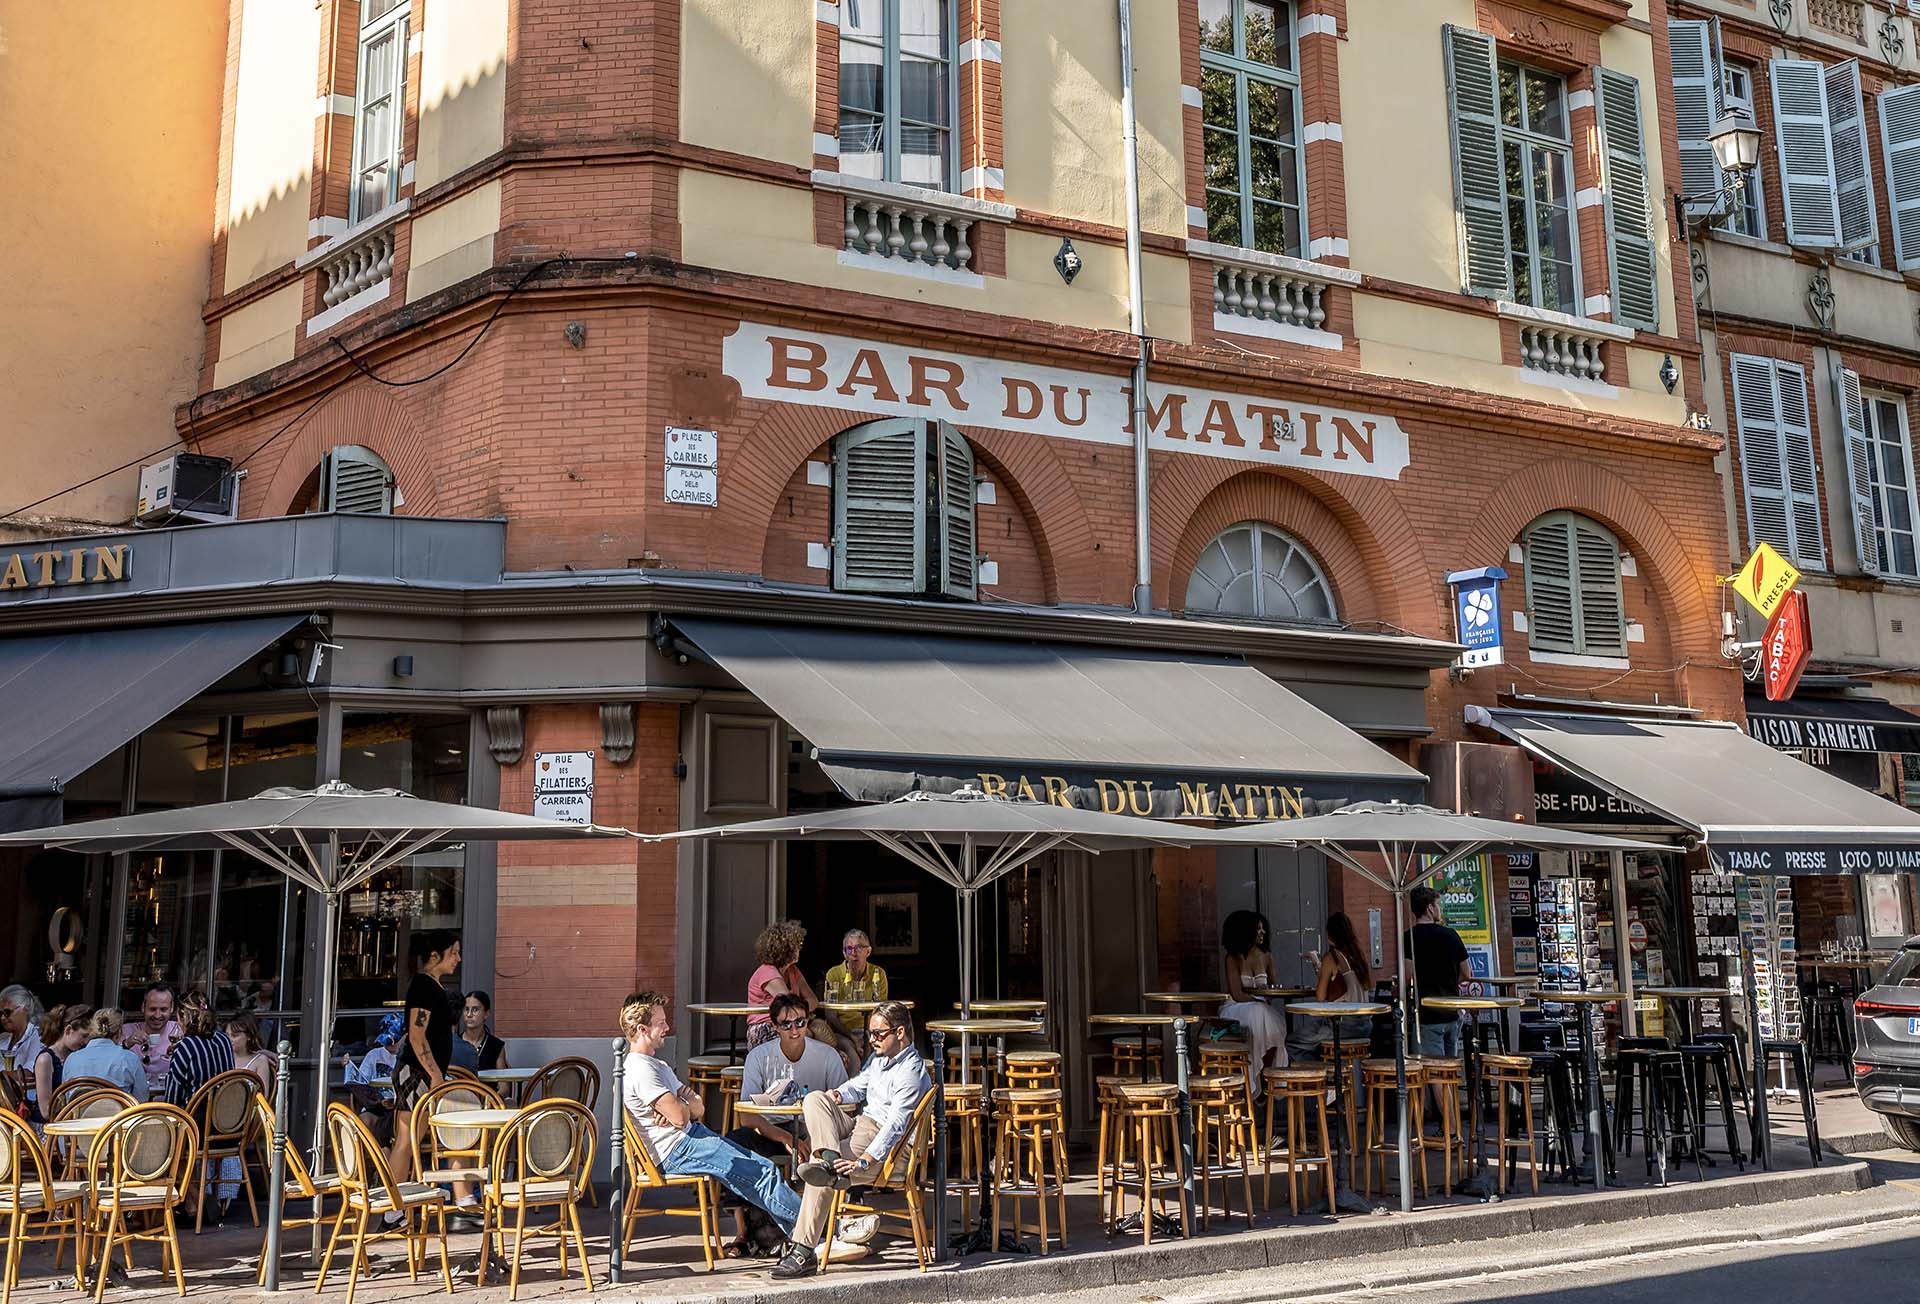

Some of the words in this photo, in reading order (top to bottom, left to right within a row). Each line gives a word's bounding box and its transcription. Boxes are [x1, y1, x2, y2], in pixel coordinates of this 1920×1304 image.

[765, 336, 969, 411] BAR
[1001, 376, 1091, 426] DU
[1120, 386, 1376, 463] MATIN
[681, 432, 703, 442] PLACE
[673, 451, 708, 464] CARMES
[671, 489, 712, 503] CARMES
[0, 544, 128, 589] ATIN
[1761, 569, 1793, 611] PRESSE
[1769, 617, 1787, 682] TABAC
[1746, 718, 1803, 746] AISON
[1806, 721, 1877, 750] SARMENT
[555, 755, 573, 764] RUE
[559, 767, 569, 775] DES
[540, 777, 587, 789] FILATIERS
[977, 773, 1074, 809] BAR
[1095, 779, 1153, 816] DU
[1177, 782, 1303, 820] MATIN
[1571, 795, 1597, 812] FDJ
[1728, 851, 1772, 869] TABAC
[1785, 851, 1827, 869] PRESSE
[1839, 851, 1872, 869] LOTO
[1877, 851, 1894, 868] DU
[1444, 892, 1475, 904] 2050
